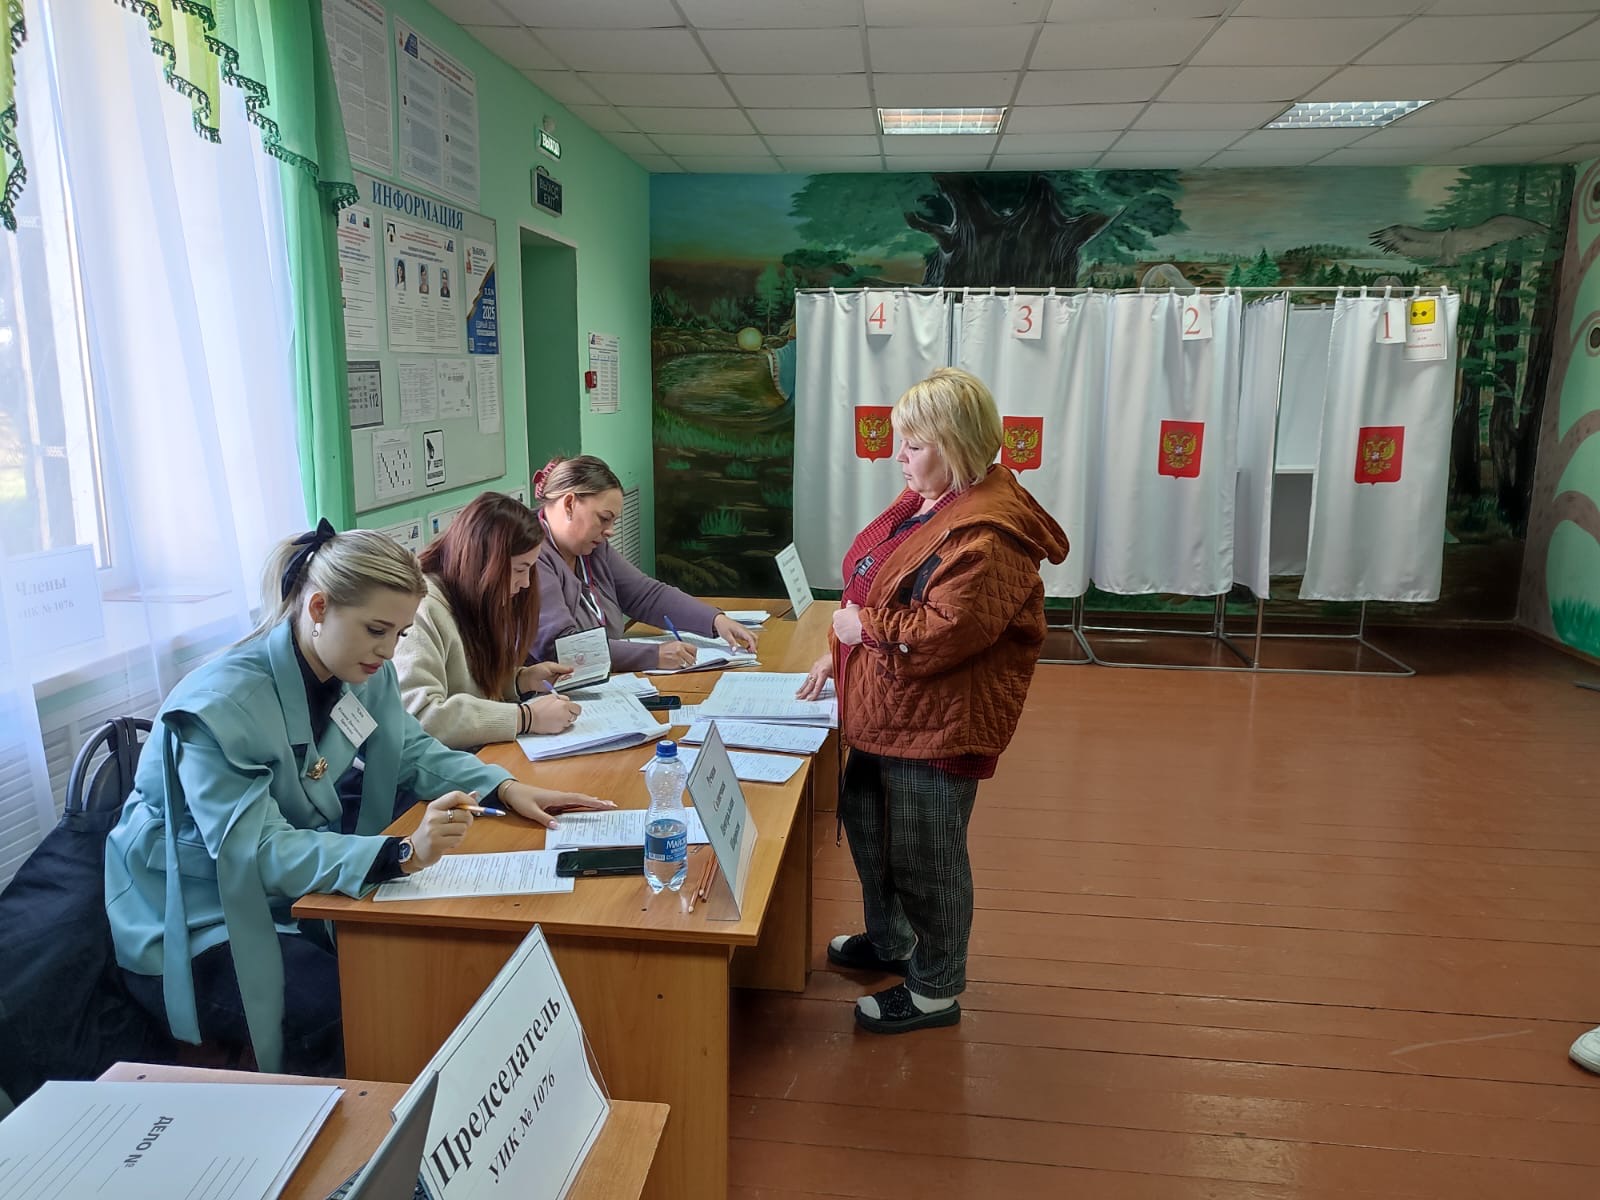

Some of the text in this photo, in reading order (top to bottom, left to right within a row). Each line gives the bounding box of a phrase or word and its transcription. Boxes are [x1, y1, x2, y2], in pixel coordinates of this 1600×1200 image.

[372, 181, 463, 231] ИНФОРМАЦИЯ
[868, 302, 887, 329] 4
[1016, 305, 1033, 334] 3
[1184, 307, 1201, 335] 2
[1383, 311, 1393, 339] 1
[369, 393, 379, 409] 112
[430, 997, 562, 1190] Председатель
[136, 1116, 174, 1151] ДЕЛО
[488, 1066, 556, 1183] УИК № 1076
